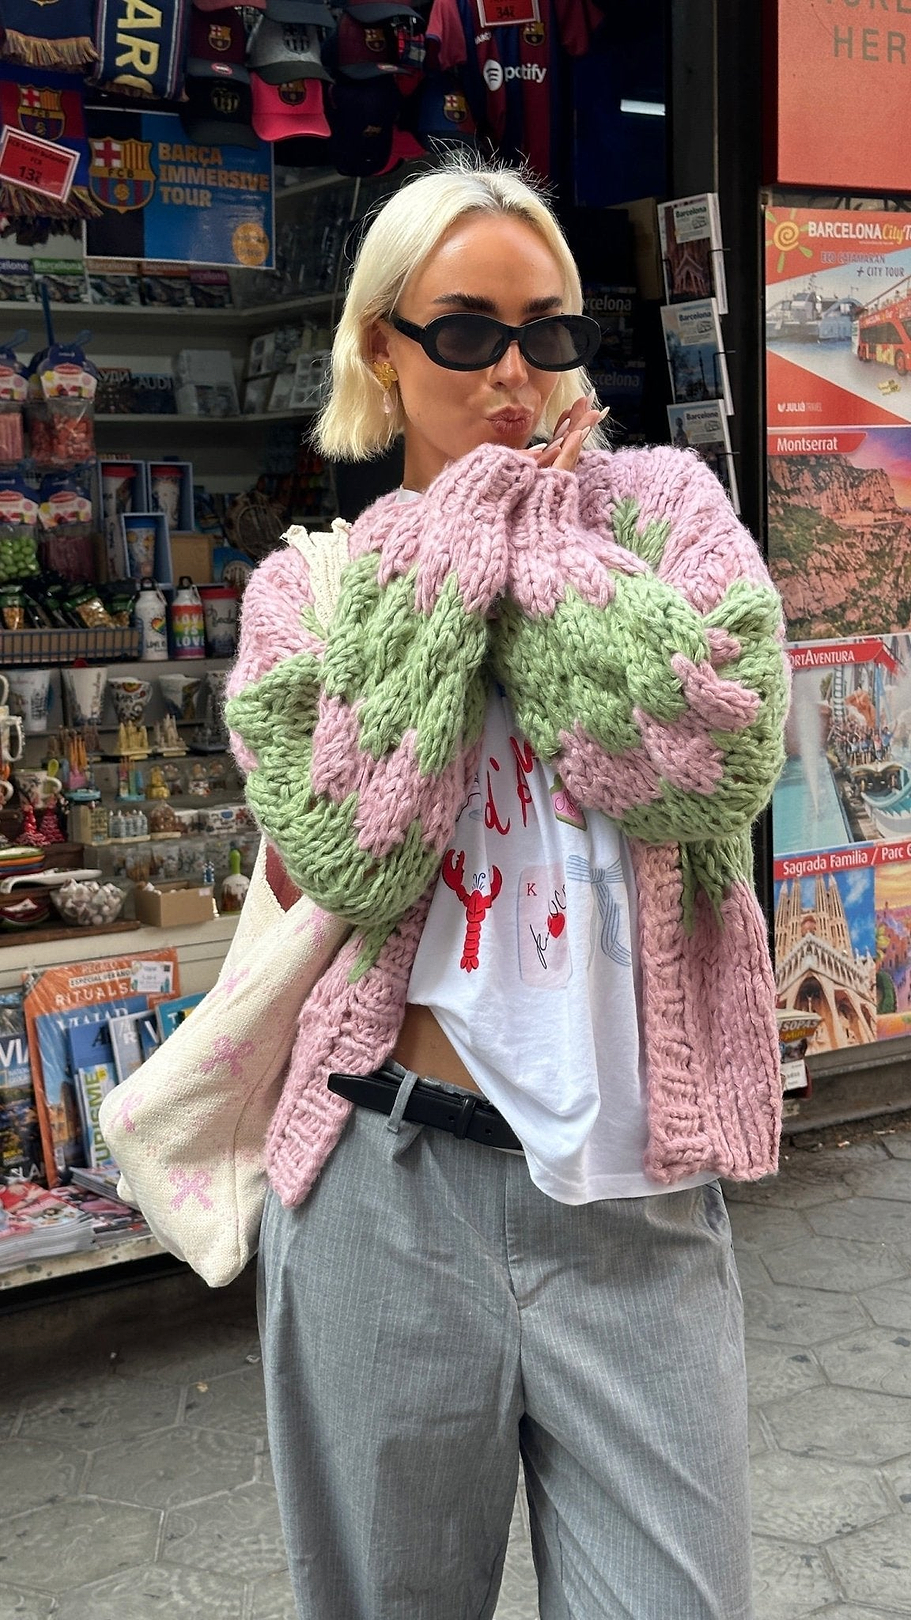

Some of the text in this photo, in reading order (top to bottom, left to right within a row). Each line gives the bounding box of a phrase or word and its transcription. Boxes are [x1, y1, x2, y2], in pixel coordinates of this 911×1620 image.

[833, 25, 906, 64] HER
[504, 63, 547, 83] potify
[158, 142, 223, 167] BARÇA
[158, 164, 270, 193] IMMERSIVE
[159, 186, 213, 207] TOUR
[808, 221, 882, 240] BARCELONA
[882, 223, 904, 245] City
[866, 266, 882, 277] CITY
[885, 267, 905, 278] TOUR
[583, 294, 633, 311] rcelona
[776, 436, 838, 452] Montserrat
[789, 648, 855, 667] ORTAVENTURA
[782, 855, 827, 877] Sagrada
[830, 849, 868, 868] Familia
[881, 846, 904, 861] Parc
[526, 882, 537, 896] K
[781, 1019, 818, 1032] SOPAS
